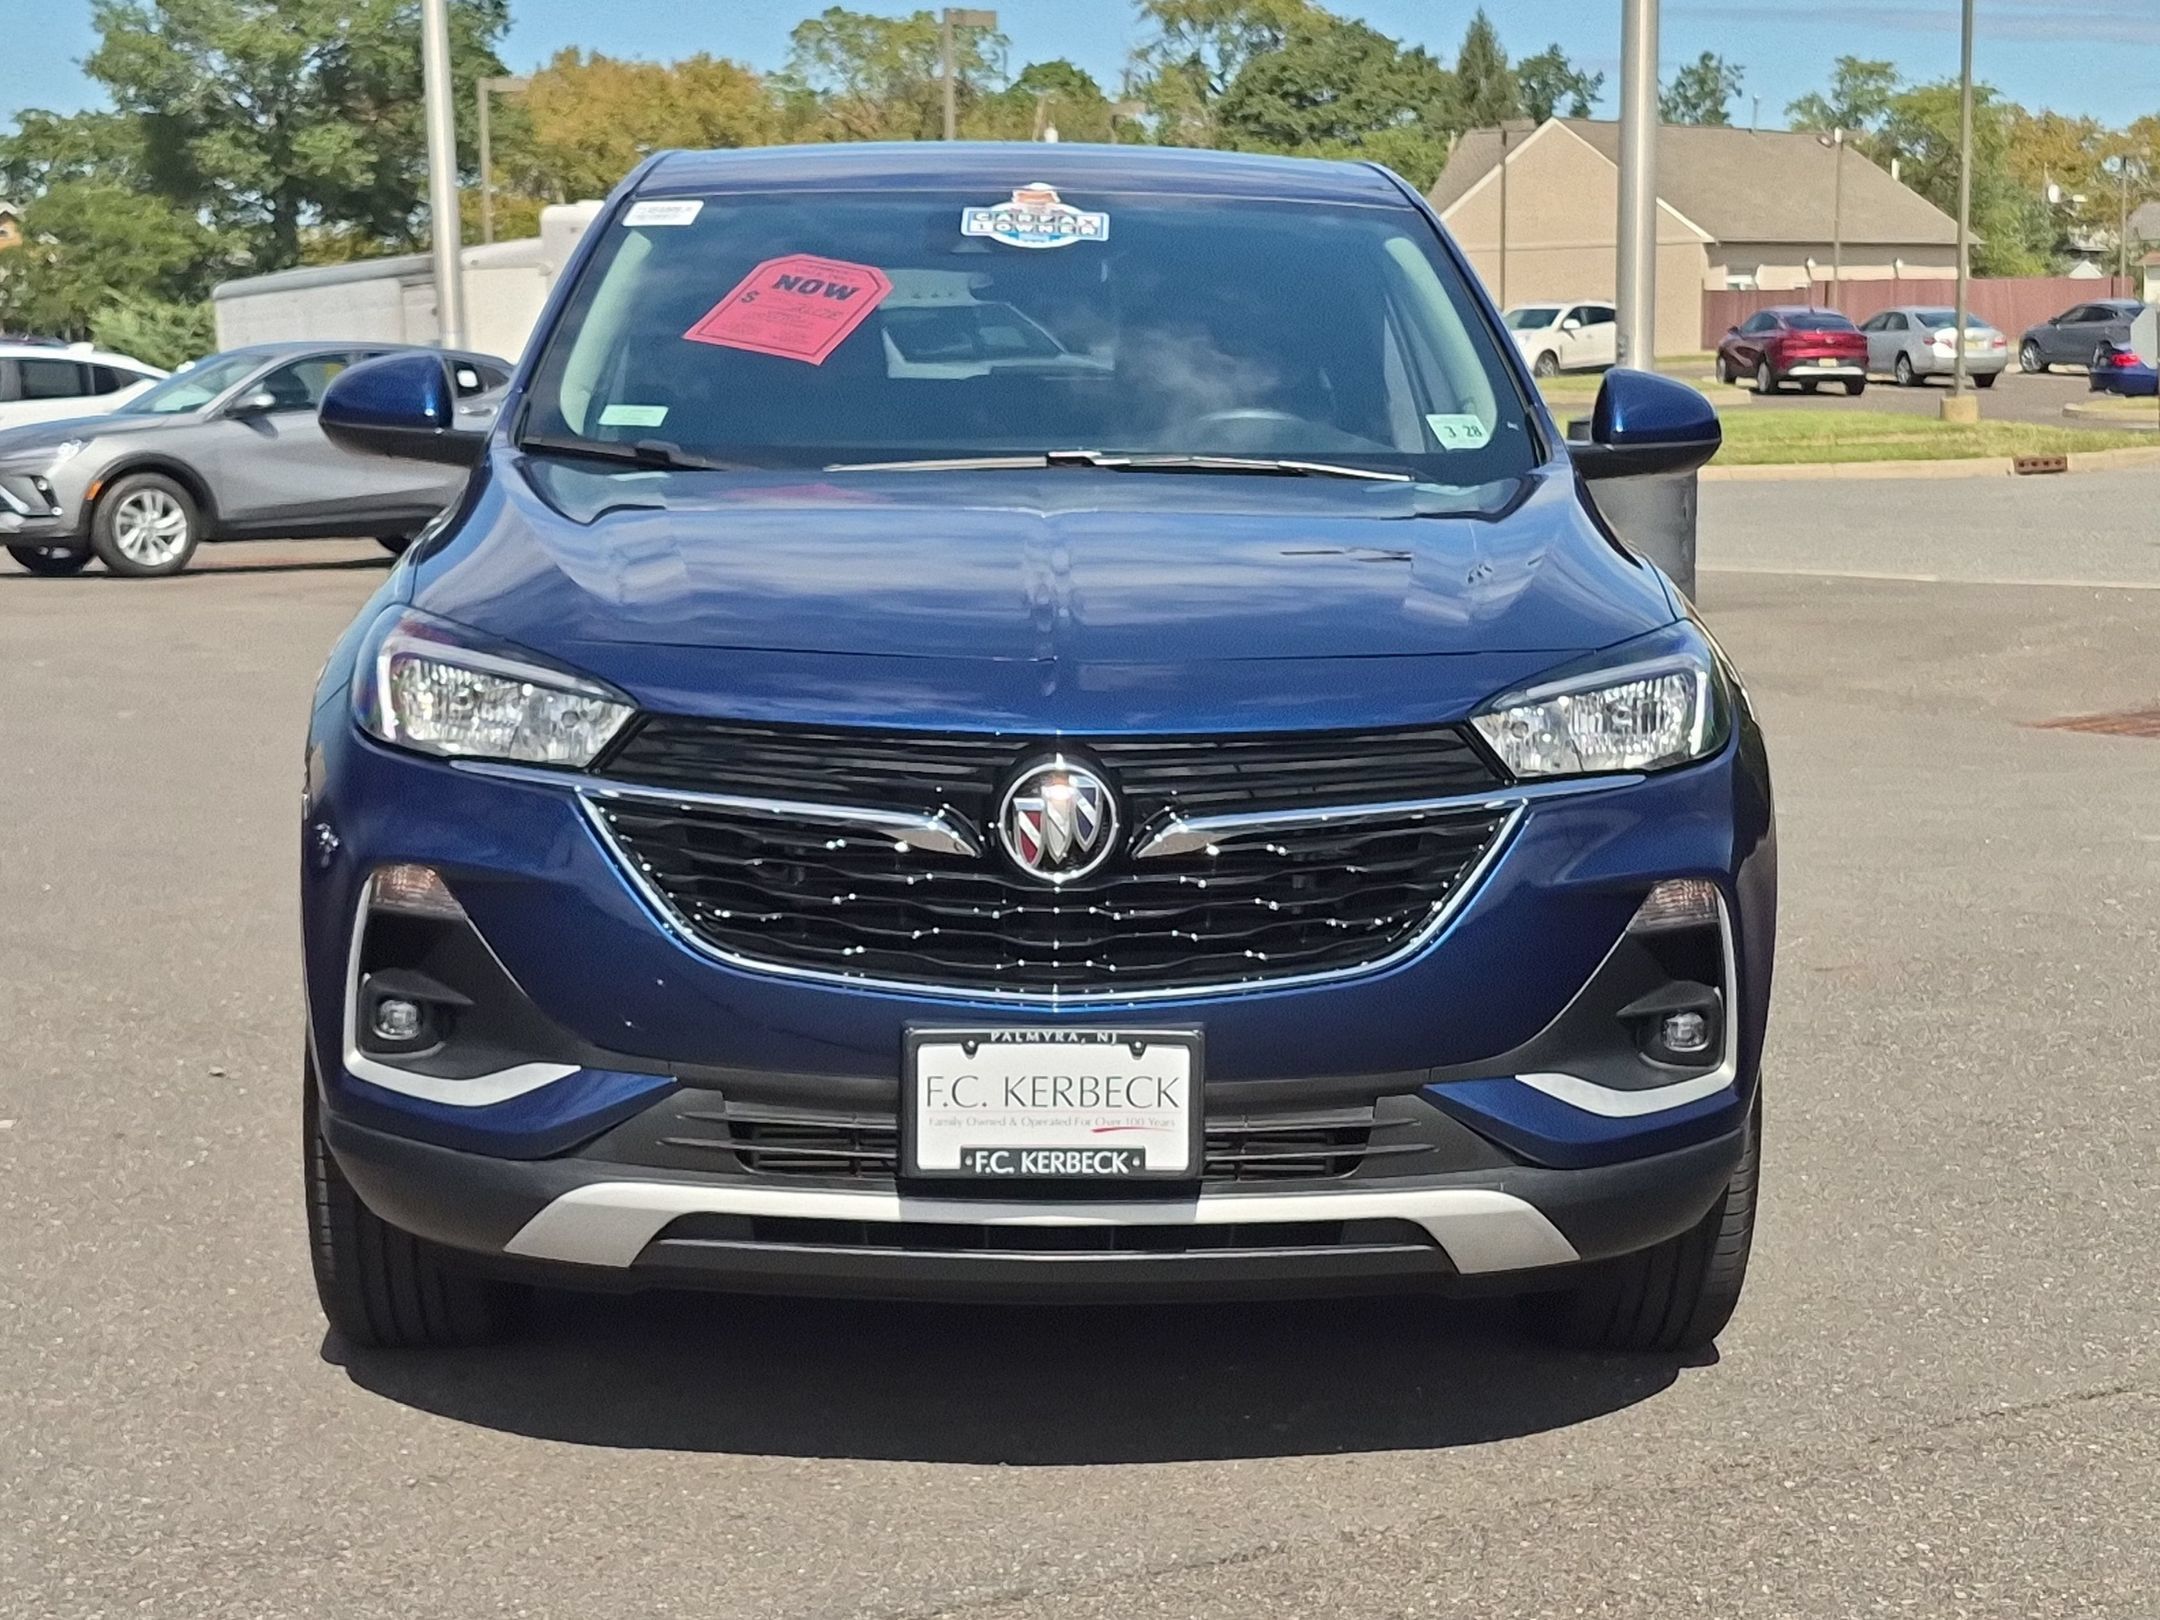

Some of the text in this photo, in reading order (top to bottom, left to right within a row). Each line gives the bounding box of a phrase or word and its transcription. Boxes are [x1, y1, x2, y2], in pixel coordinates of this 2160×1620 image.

[975, 211, 1101, 227] CARFAX
[994, 222, 1097, 236] OWNER
[772, 274, 862, 300] NOW
[741, 290, 759, 304] $
[990, 1031, 1118, 1044] PALMYRA, NJ
[926, 1075, 1180, 1108] F.C. KERBECK
[929, 1116, 1176, 1128] Family Owned & Operated For Over 100 Years
[975, 1151, 1129, 1174] F.C. KERBECK
